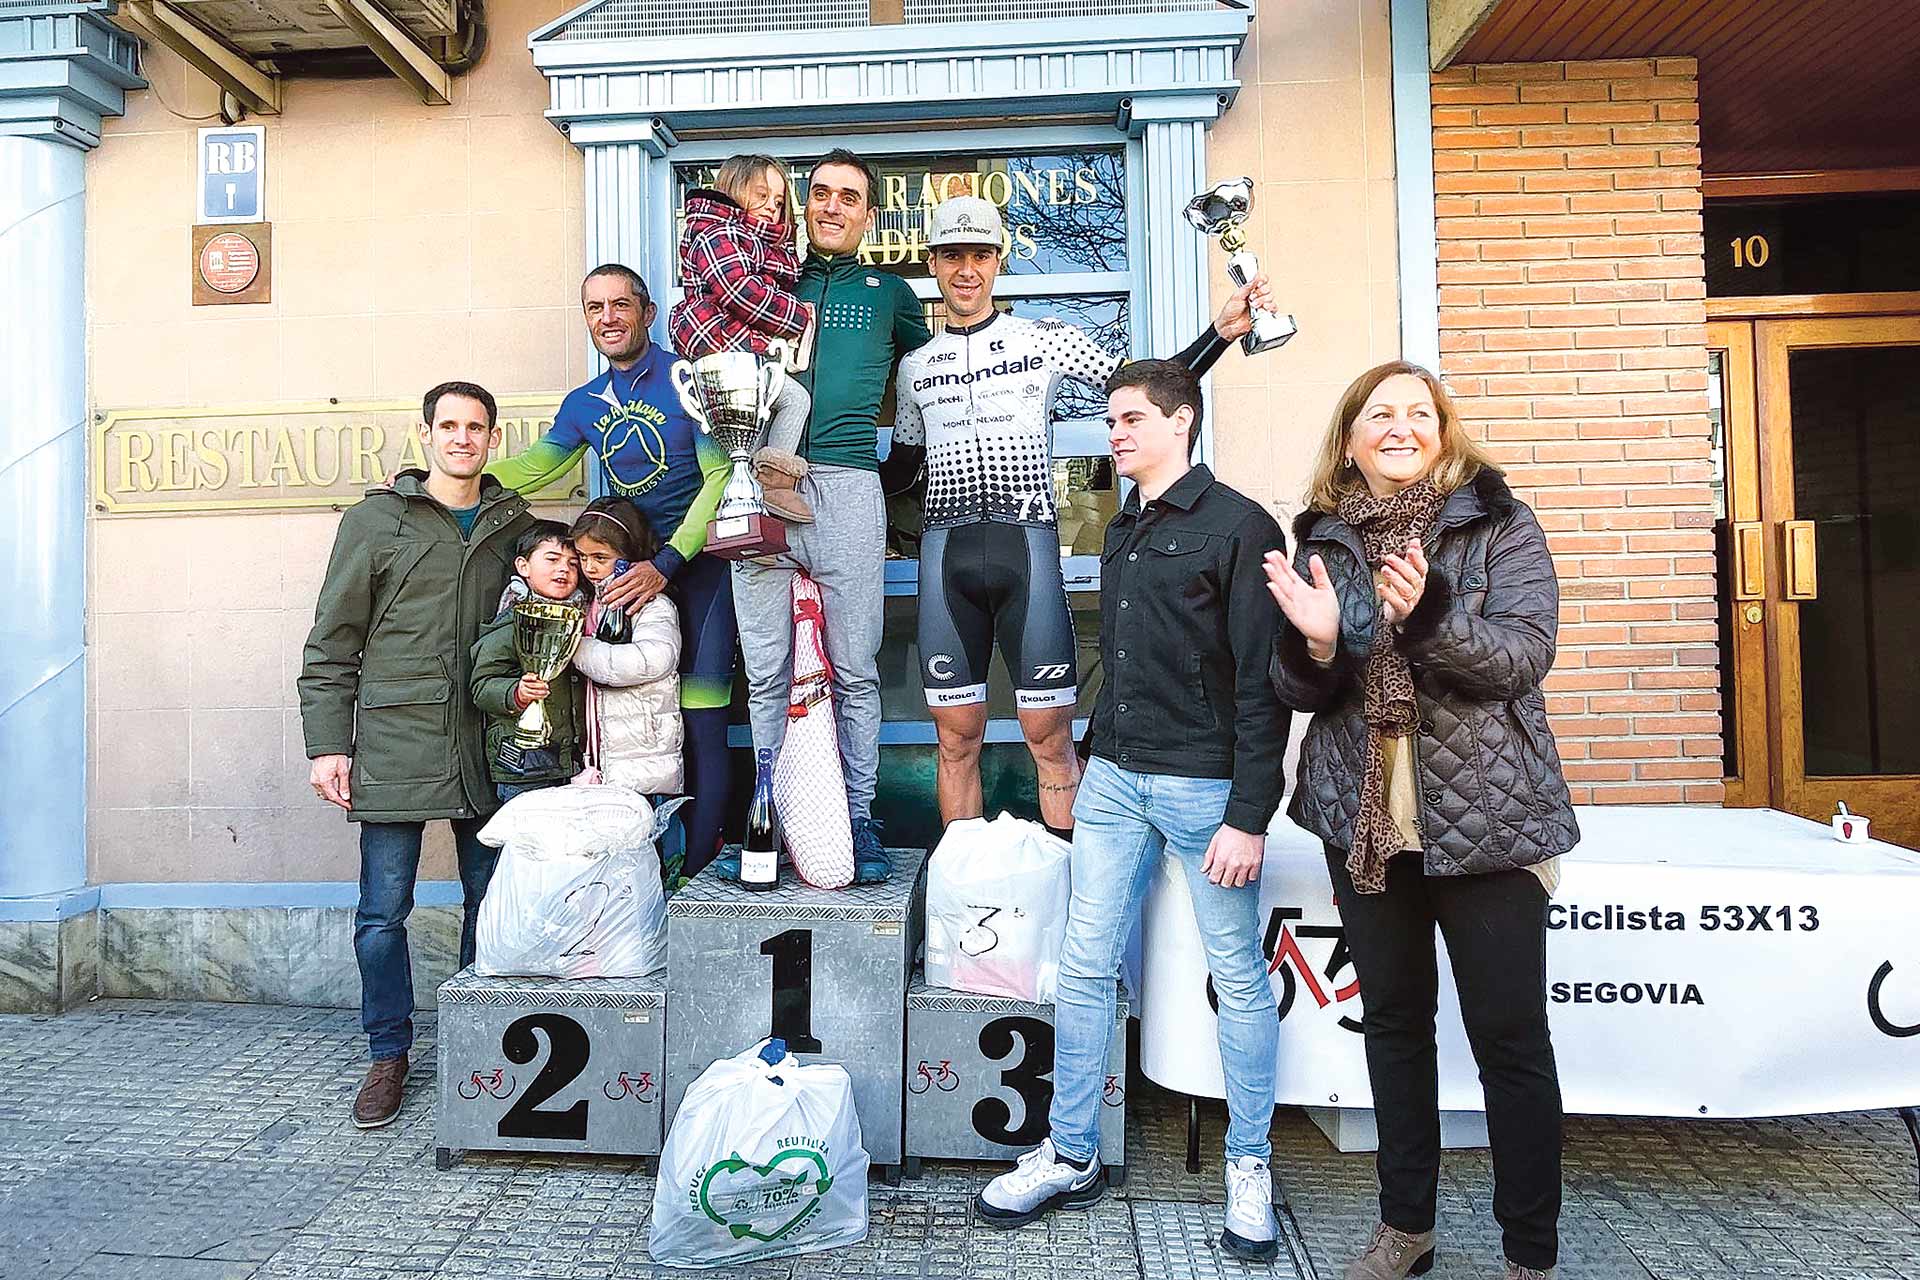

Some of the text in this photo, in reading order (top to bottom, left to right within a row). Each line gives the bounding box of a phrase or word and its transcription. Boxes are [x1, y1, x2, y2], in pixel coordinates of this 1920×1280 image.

[206, 142, 256, 176] RB
[882, 168, 1097, 212] RACIONES
[1730, 235, 1769, 268] 10
[913, 355, 1043, 392] cannondale
[943, 419, 972, 429] MONTE
[114, 416, 556, 493] RESTAURAT
[1547, 904, 1820, 932] Ciclista 53X13
[760, 929, 823, 1054] 1
[1550, 982, 1705, 1005] SEGOVIA
[497, 1012, 591, 1141] 2
[971, 1016, 1057, 1147] 3
[776, 1135, 830, 1157] REUTILIZA
[762, 1186, 799, 1204] 70%
